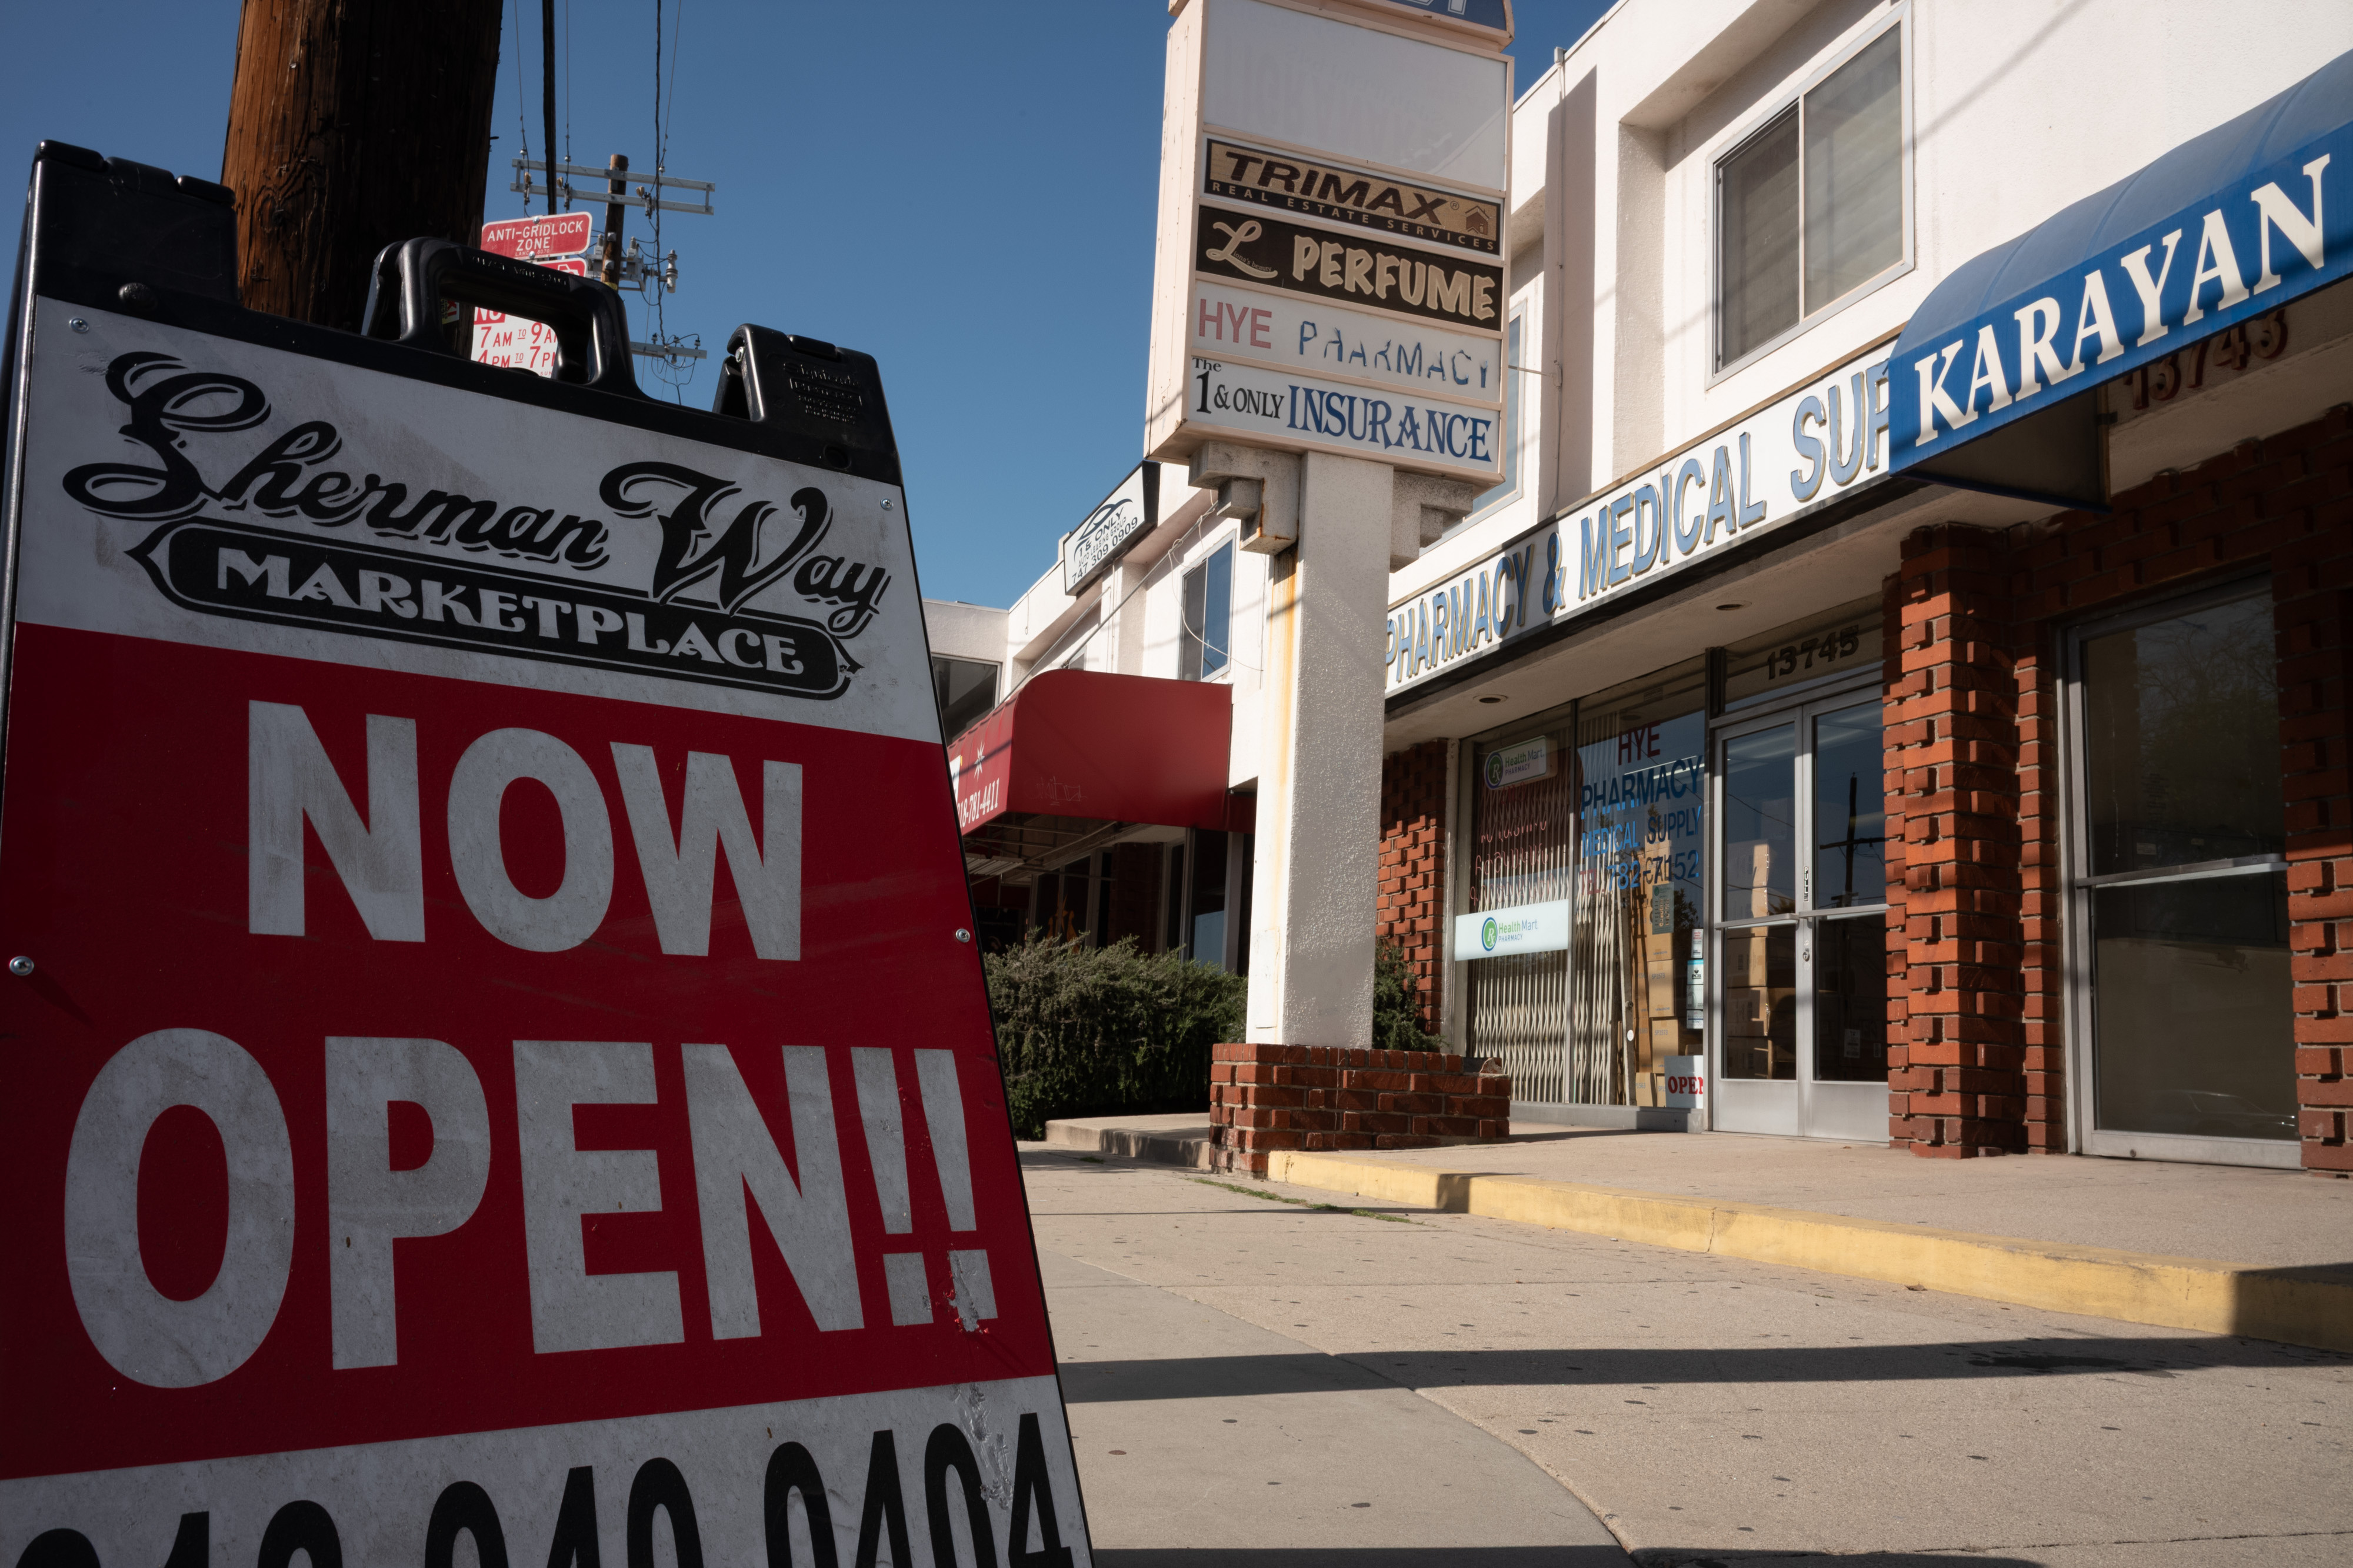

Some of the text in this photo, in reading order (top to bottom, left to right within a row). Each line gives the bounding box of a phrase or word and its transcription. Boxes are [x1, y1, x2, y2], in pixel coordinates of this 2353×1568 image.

[487, 221, 584, 242] ANTI-GRIDLOCK
[1212, 182, 1495, 251] REAL ESTATE SERVICES
[516, 236, 551, 251] ZONE
[1252, 261, 1272, 272] beauty
[1292, 234, 1496, 321] PERFUME
[1915, 154, 2330, 447] KARAYAN
[481, 326, 492, 348] 7
[493, 332, 512, 348] AM
[518, 329, 526, 339] TO
[531, 322, 542, 345] 9
[1198, 299, 1272, 349] HYE
[515, 352, 524, 363] TO
[530, 346, 541, 368] 7
[542, 352, 555, 368] P
[1192, 357, 1222, 372] The
[1197, 371, 1492, 463] 1 & ONLY INSURANCE
[62, 351, 892, 637] Sherman Way
[1078, 516, 1126, 568] AUTO LEASING GROUP
[1095, 506, 1124, 541] ONLY
[1072, 517, 1138, 583] 747 309 0909
[1385, 543, 1535, 689] PHARMACY
[1542, 531, 1567, 615] &
[1578, 431, 1767, 601] MEDICAL
[215, 546, 805, 676] MARKETPLACE
[1767, 625, 1859, 680] 13745
[1505, 752, 1527, 768] Health
[1618, 720, 1661, 766] HYE
[1505, 763, 1531, 776] PHARMACY
[1581, 755, 1703, 820] PHARMACY
[249, 699, 802, 961] NOW
[1581, 821, 1640, 859] MEDICAL
[1648, 805, 1702, 845] SUPPLY
[1607, 849, 1699, 891] 782-7152
[1498, 933, 1522, 943] PHARMACY
[1499, 920, 1521, 934] Health
[64, 1027, 998, 1389] OPEN!!
